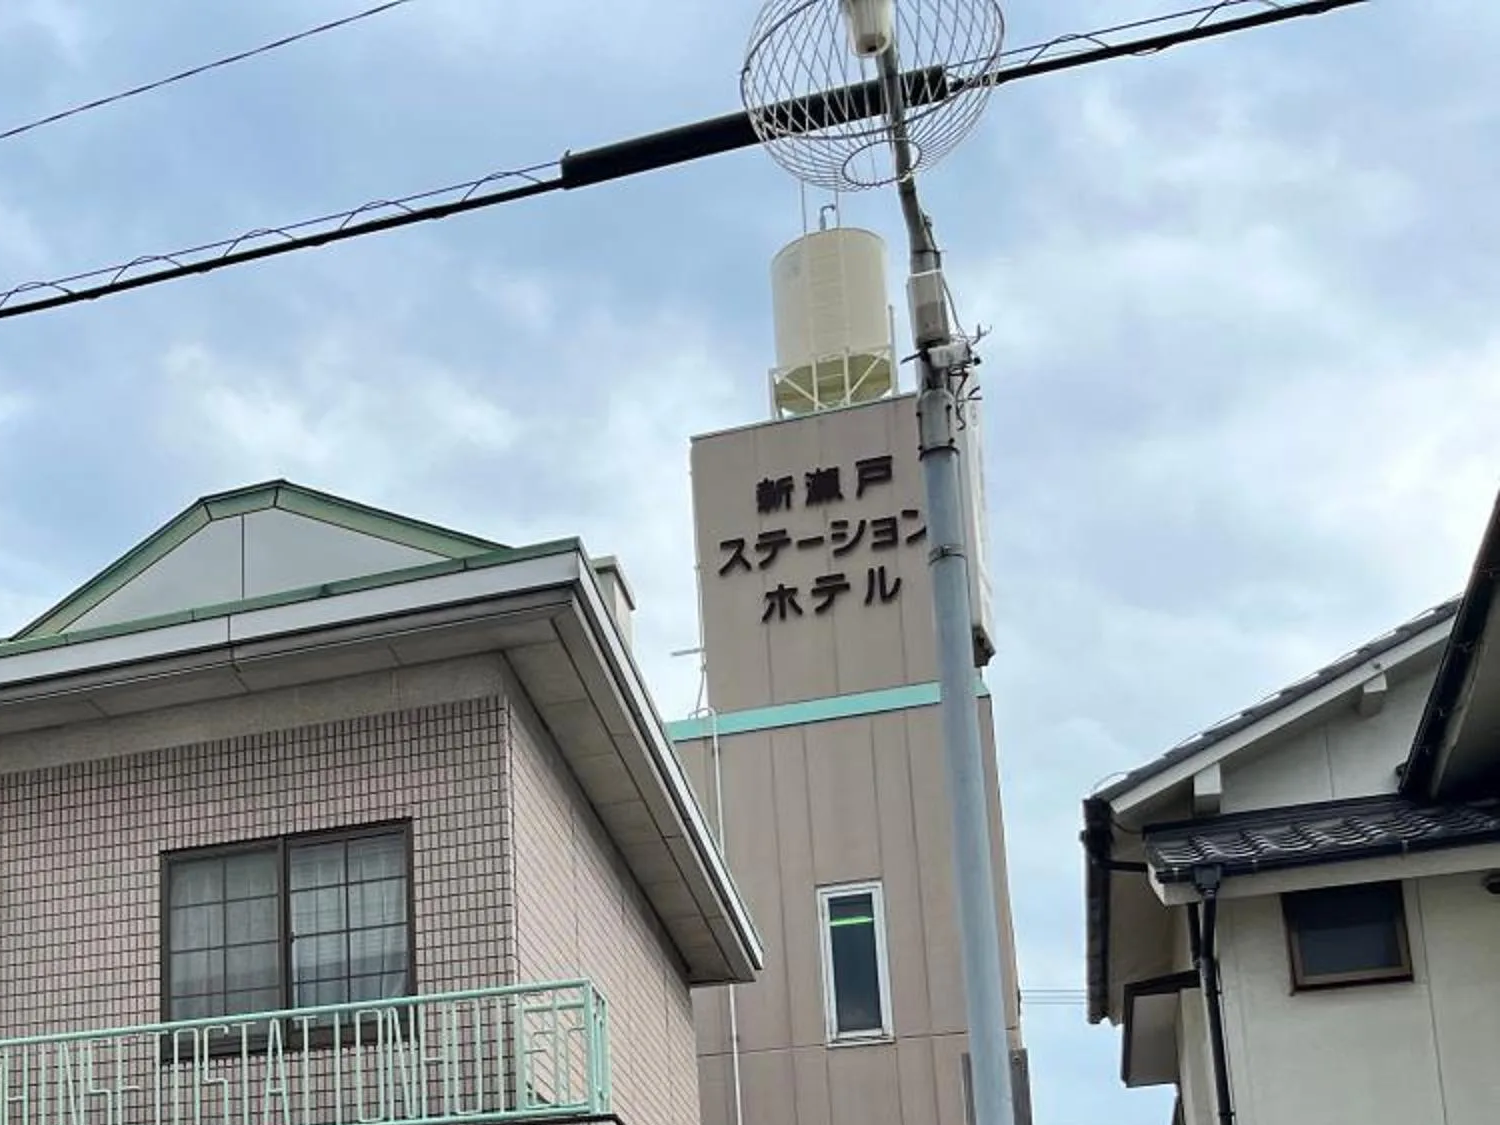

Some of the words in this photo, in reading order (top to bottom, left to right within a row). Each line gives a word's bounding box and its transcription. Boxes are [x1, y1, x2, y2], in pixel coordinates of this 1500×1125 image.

[756, 455, 893, 513] 新瀬戸
[719, 508, 927, 577] ステーション
[761, 565, 901, 623] ホテル
